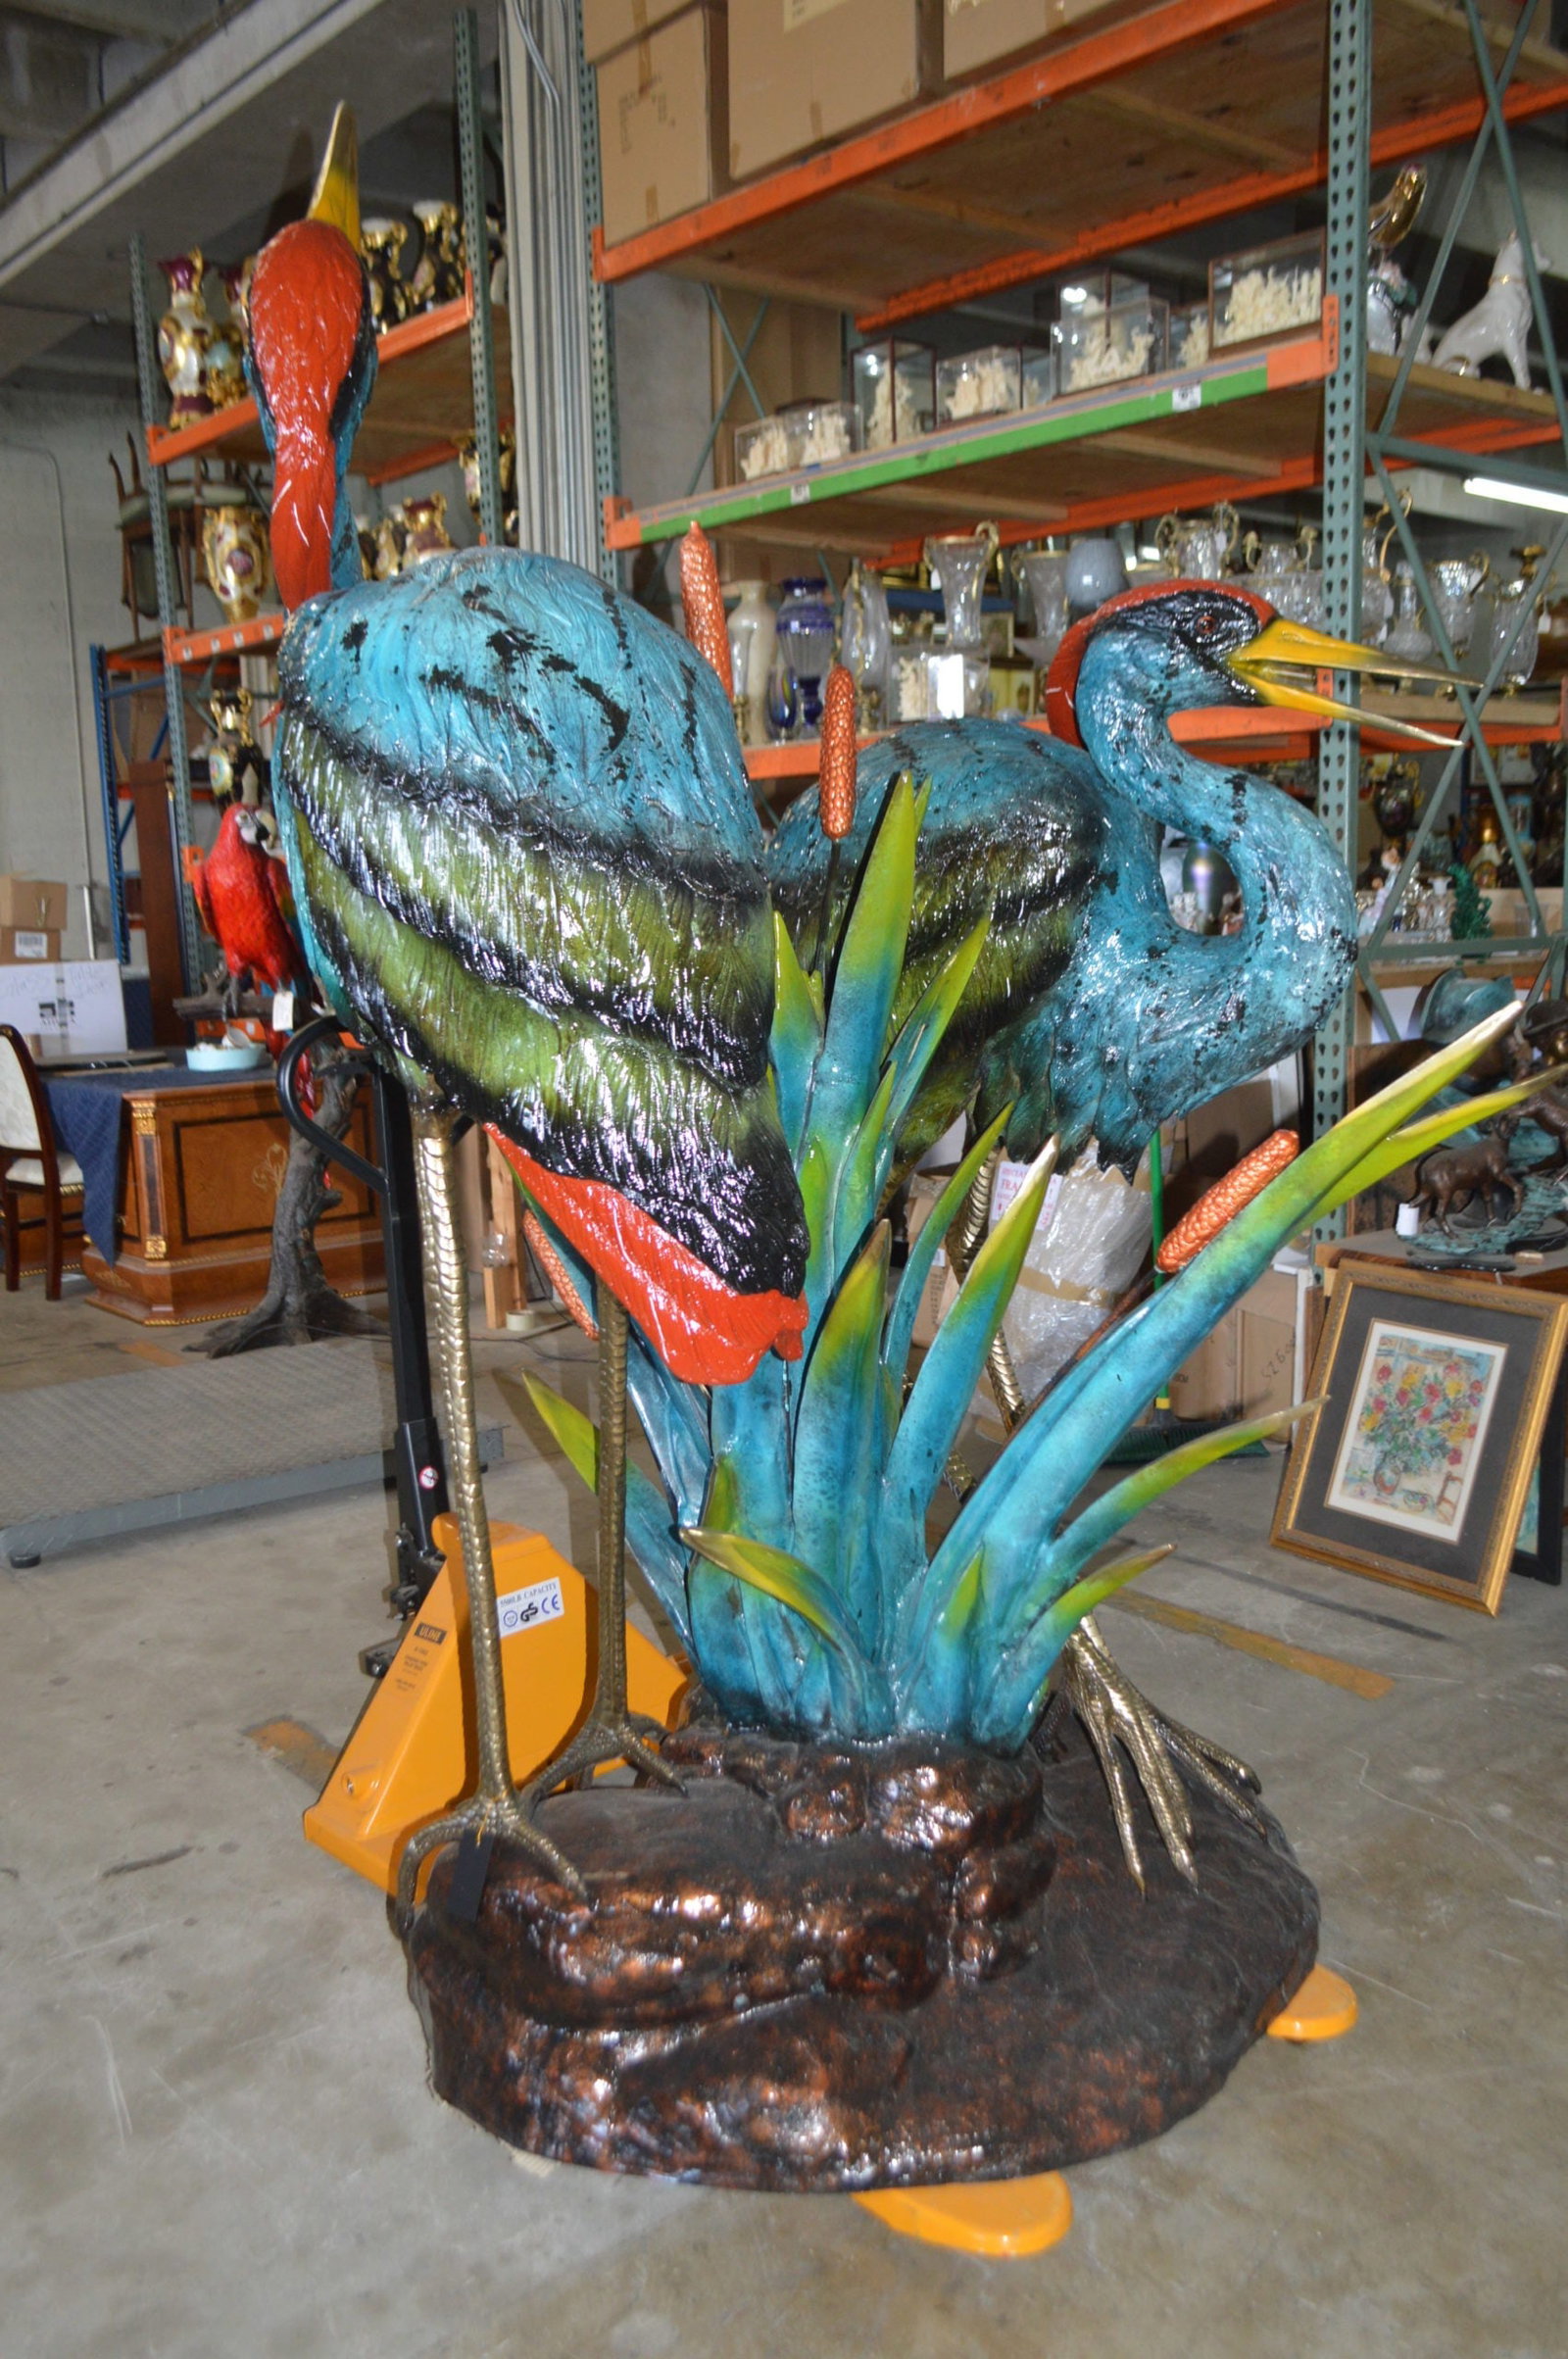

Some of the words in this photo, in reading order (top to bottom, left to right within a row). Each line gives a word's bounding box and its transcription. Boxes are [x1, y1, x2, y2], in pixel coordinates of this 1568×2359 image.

[524, 1582, 558, 1598] CAPACITY
[541, 1594, 561, 1614] CE
[418, 1626, 443, 1643] ULINE
